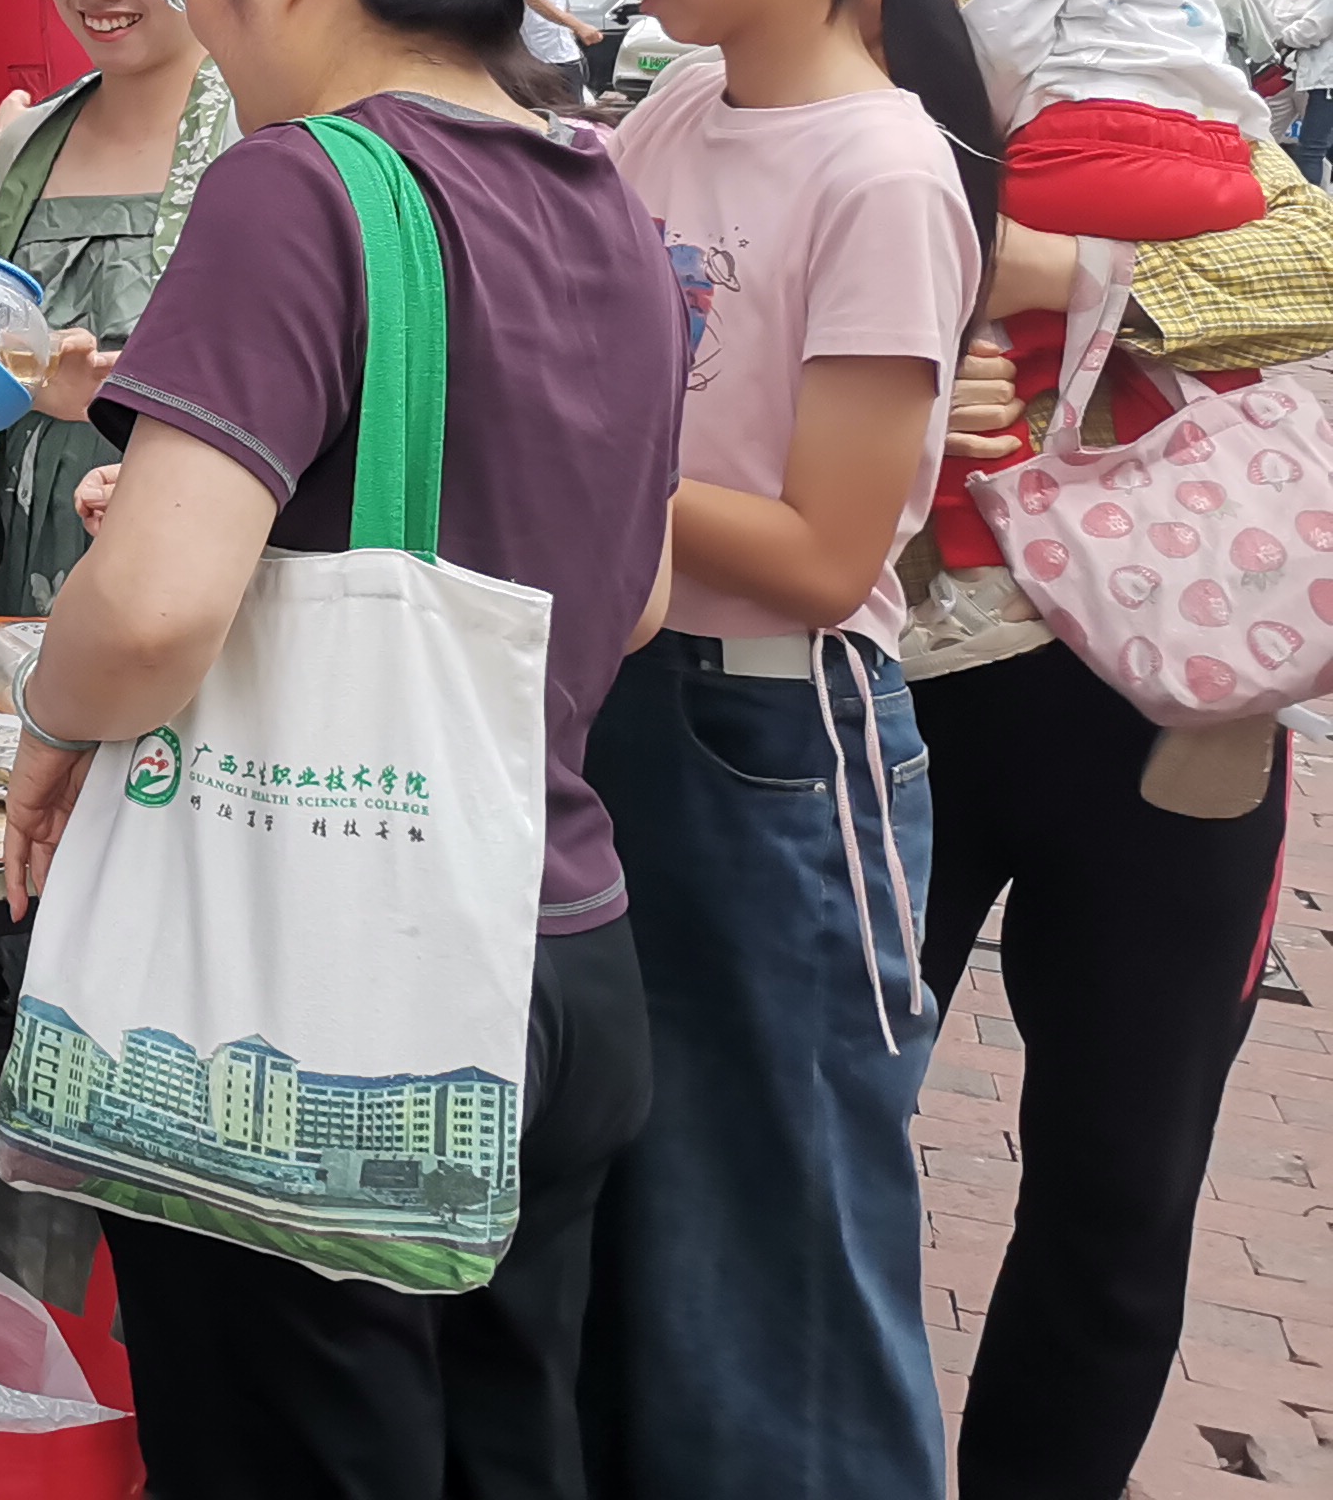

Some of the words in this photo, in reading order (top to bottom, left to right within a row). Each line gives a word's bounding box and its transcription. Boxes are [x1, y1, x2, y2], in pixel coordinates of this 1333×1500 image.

[189, 770, 247, 798] GUANGXI
[297, 795, 358, 809] SCIENCE
[364, 796, 430, 817] COLLEGE
[190, 742, 430, 799] 广西卫生职业技术学院
